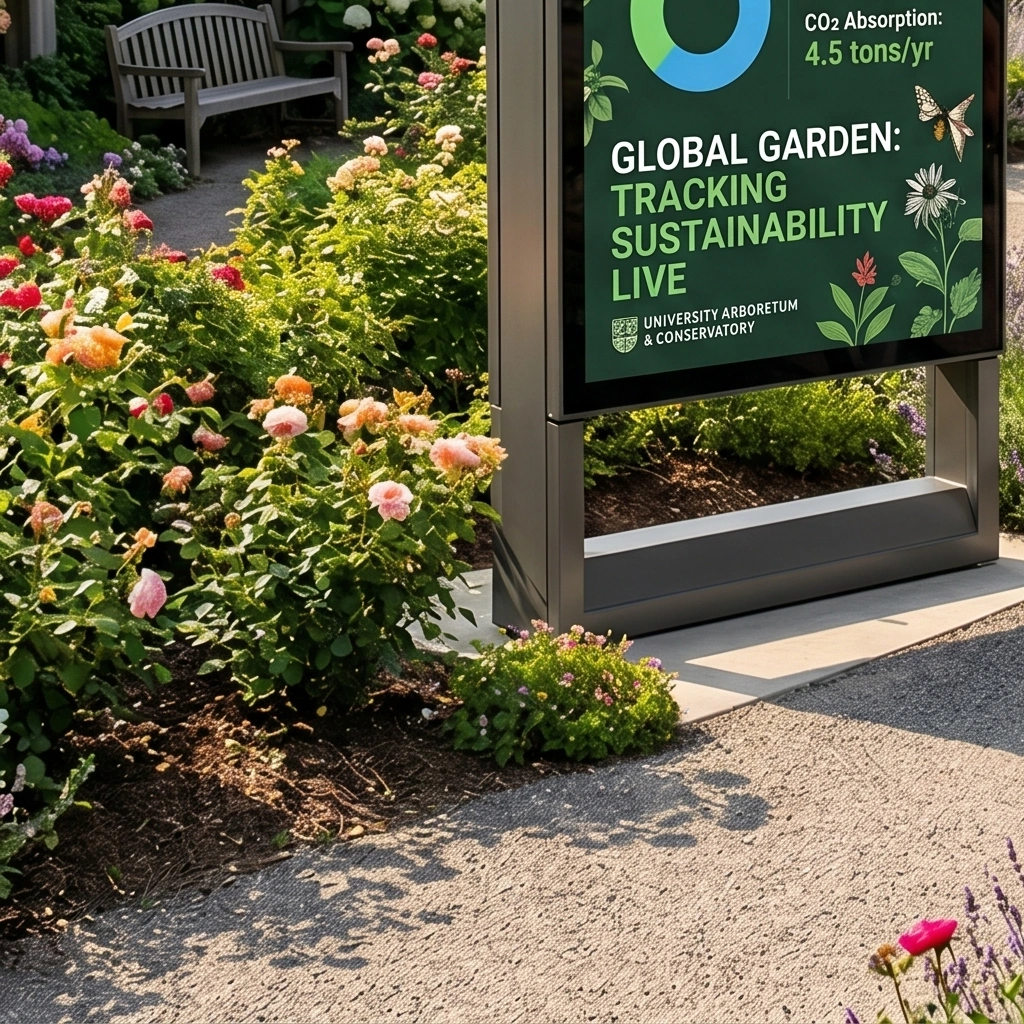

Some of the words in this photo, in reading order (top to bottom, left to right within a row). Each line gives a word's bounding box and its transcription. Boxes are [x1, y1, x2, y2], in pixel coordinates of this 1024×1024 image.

[844, 9, 942, 32] Absorption:
[805, 41, 842, 65] 4.5
[850, 37, 933, 67] tons/yr
[612, 134, 748, 174] GLOBAL
[759, 121, 900, 162] GARDEN:
[611, 171, 786, 216] TRACKING
[612, 201, 887, 258] SUSTAINABILITY
[613, 263, 686, 301] LIVE
[644, 309, 718, 329] UNIVERSITY
[722, 299, 797, 319] ARBORETUM
[644, 334, 652, 346] &
[656, 321, 754, 344] CONSERVATORY
